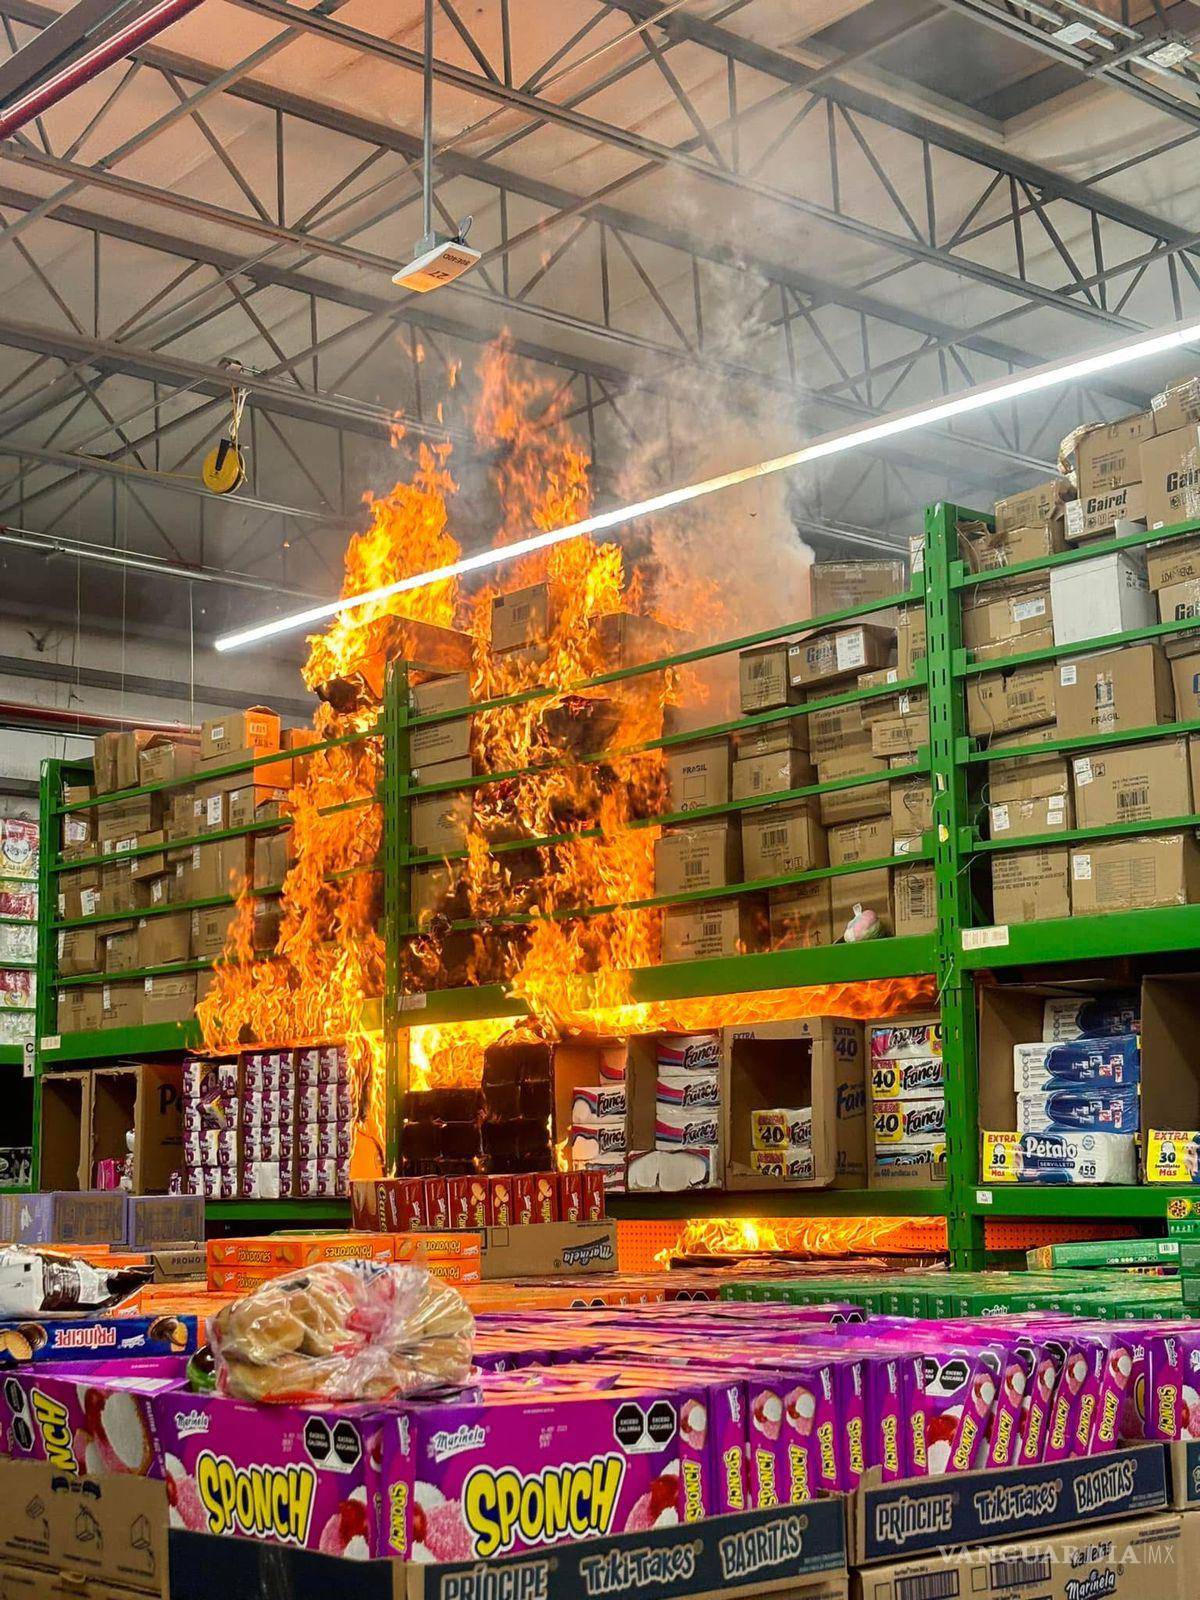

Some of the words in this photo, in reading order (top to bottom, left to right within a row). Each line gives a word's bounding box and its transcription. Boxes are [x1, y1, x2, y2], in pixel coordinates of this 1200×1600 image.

[1086, 489, 1129, 514] Gairet
[25, 1043, 34, 1053] C
[27, 1064, 32, 1072] 1
[684, 1044, 720, 1069] Fancy
[682, 1081, 719, 1107] Fancy
[902, 1063, 941, 1090] Fancy
[682, 1119, 719, 1144] Fancy
[906, 1108, 944, 1135] Fancy
[987, 1134, 1016, 1142] EXTRA
[1154, 1132, 1189, 1141] EXTRA
[992, 1154, 1006, 1165] 30
[1025, 1136, 1078, 1159] Pétalo
[1159, 1152, 1176, 1163] 30
[562, 1245, 613, 1265] Marinela
[992, 1408, 1014, 1463] SPONCH
[1024, 1403, 1043, 1459] SPONCH
[1051, 1396, 1070, 1449] SPONCH
[1076, 1394, 1096, 1446] SPONCH
[1098, 1390, 1119, 1441] SPONCH
[1157, 1384, 1177, 1436] SPONCH
[433, 1425, 487, 1453] Marinela
[817, 1422, 837, 1480] SPONCH
[847, 1416, 865, 1475] SPONCH
[882, 1414, 899, 1472] SPONCH
[911, 1410, 927, 1467] SPONCH
[953, 1414, 979, 1470] SPONCH
[199, 1452, 315, 1544] SPONCH
[682, 1458, 705, 1522] SPONCH
[724, 1446, 744, 1509] SPONCH
[788, 1443, 810, 1504] SPONCH
[1073, 1461, 1135, 1512] BARRITAS
[389, 1481, 408, 1553] SPONCH
[466, 1456, 622, 1557] SPONCH
[721, 1519, 802, 1579] BARRITAS
[1065, 1570, 1117, 1600] Marinela
